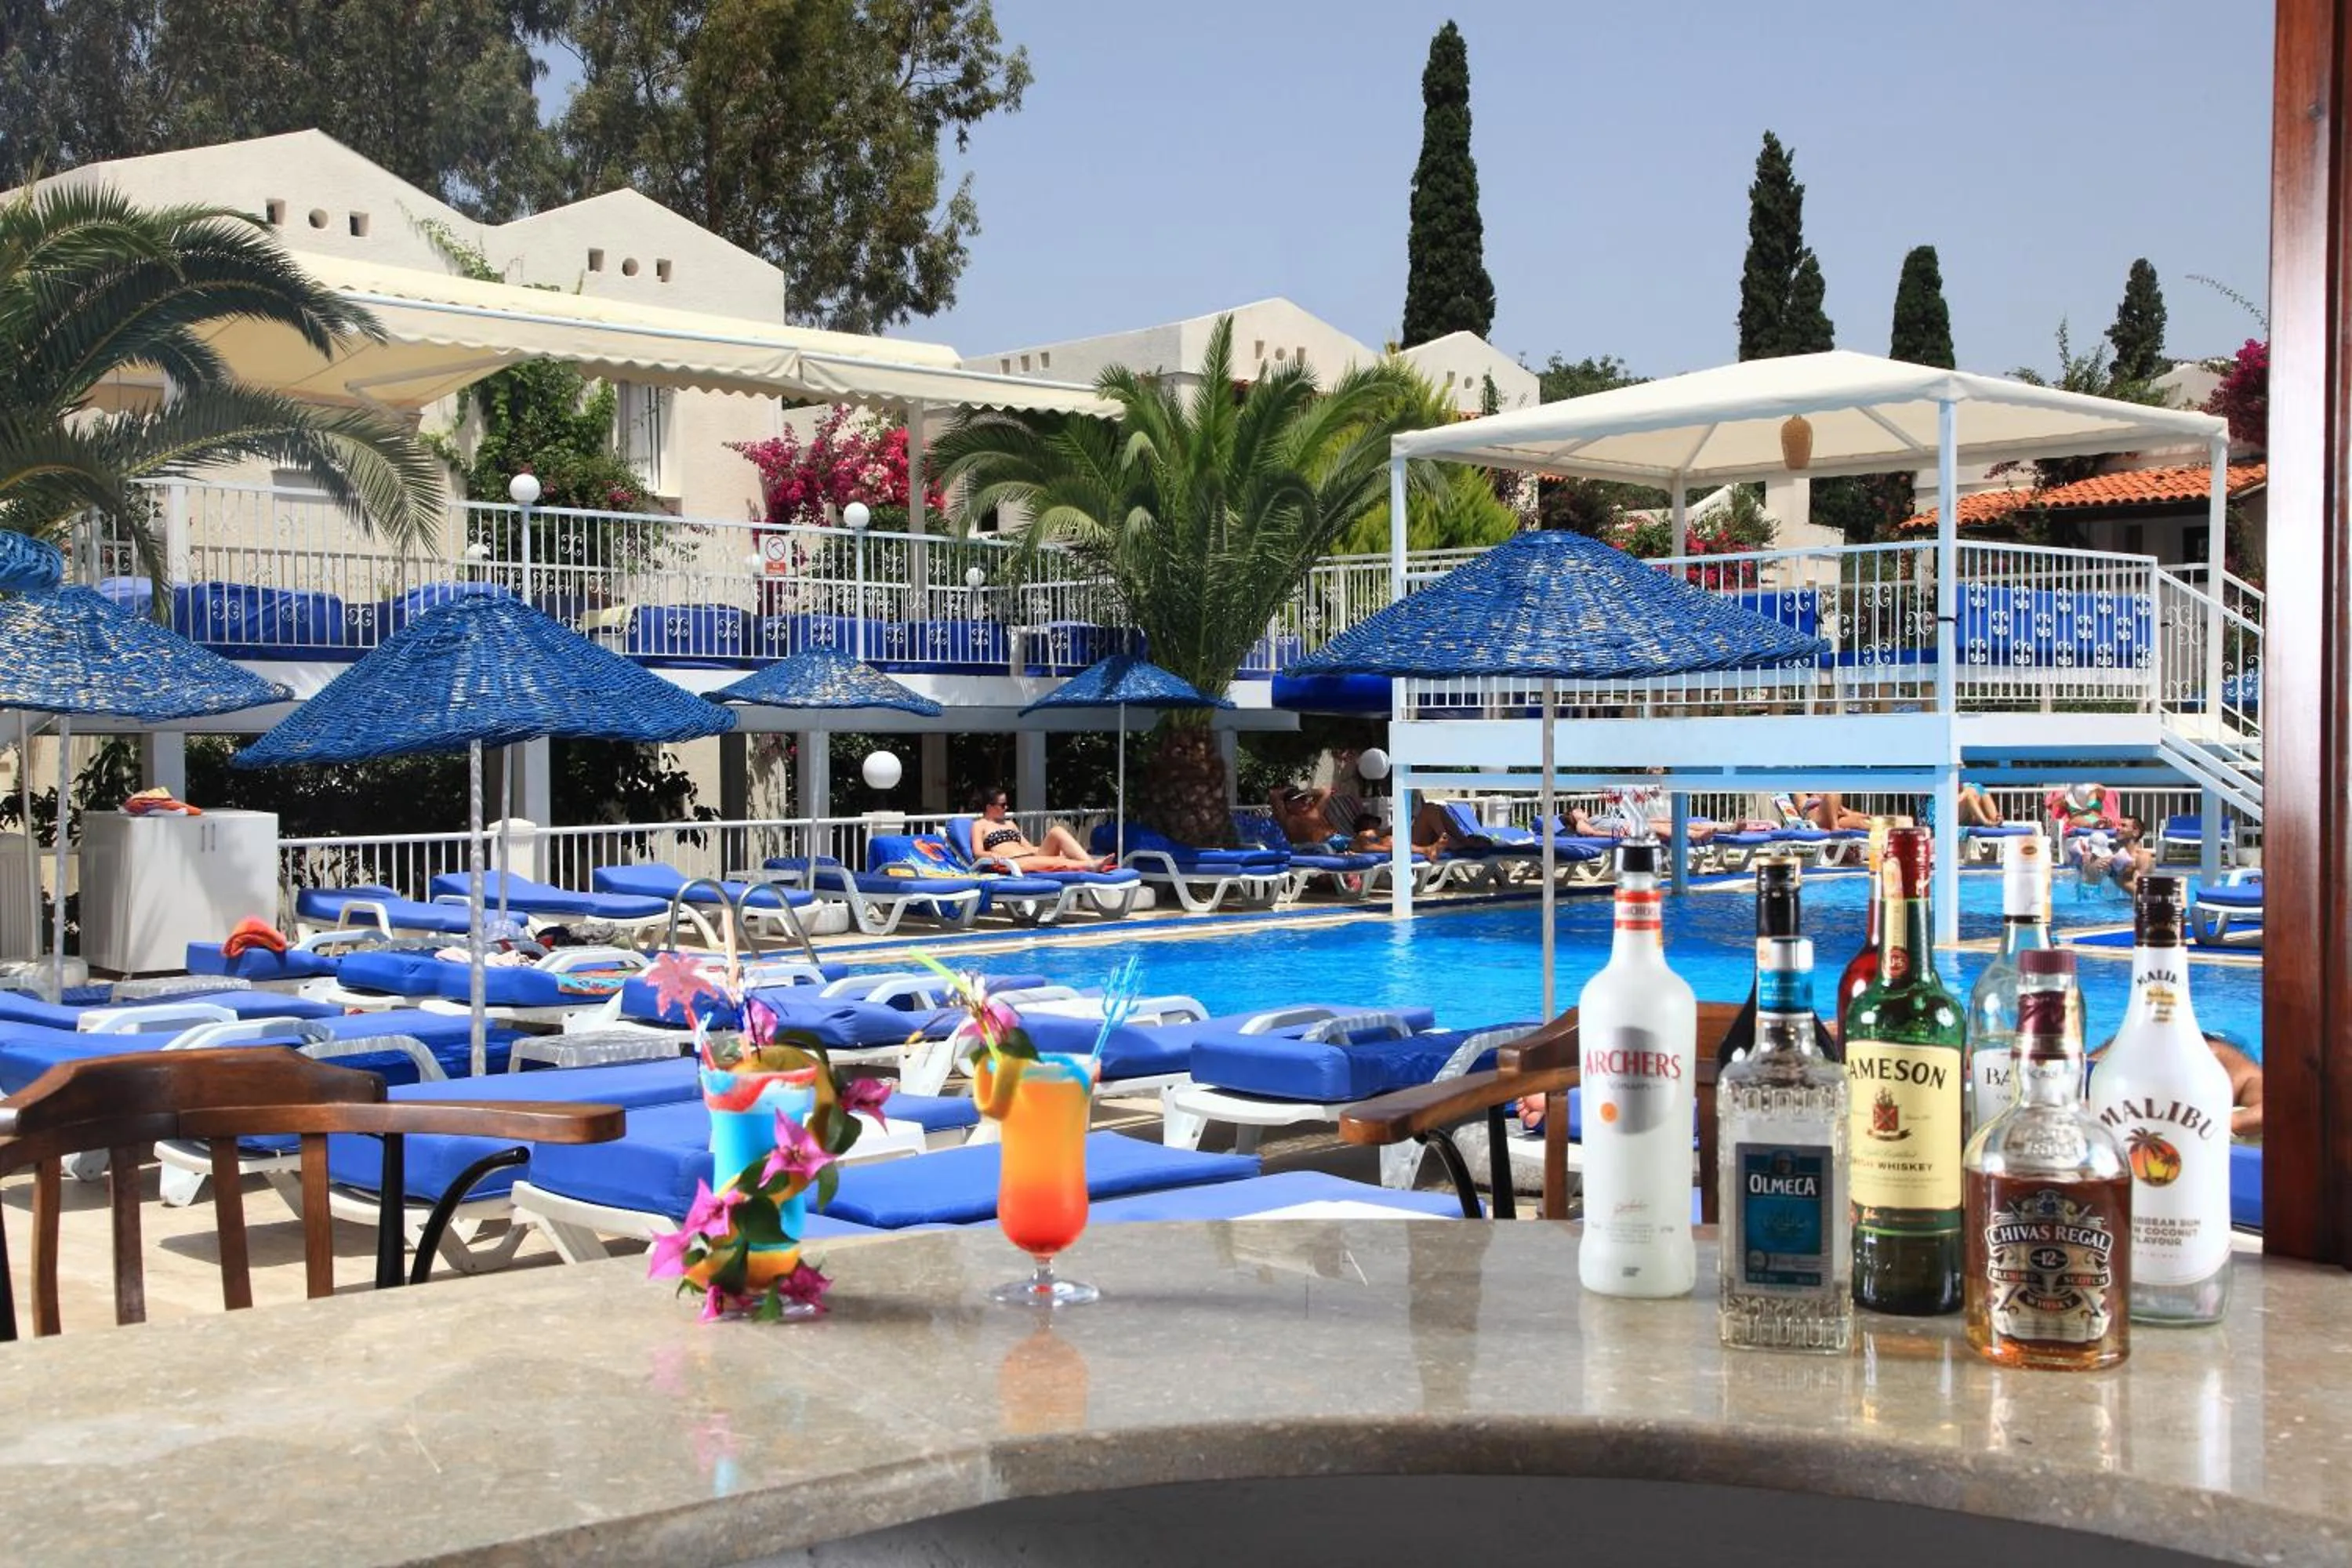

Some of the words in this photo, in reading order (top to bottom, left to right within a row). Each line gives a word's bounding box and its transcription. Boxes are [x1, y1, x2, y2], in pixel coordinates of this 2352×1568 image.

[1584, 1048, 1682, 1080] ARCHERS
[1849, 1058, 1947, 1091] AMESON
[2100, 1098, 2216, 1140] MALIBU
[1878, 1162, 1933, 1171] WHISKEY
[1749, 1174, 1817, 1196] OLMECA
[1990, 1225, 2050, 1244] CHIVAS
[2055, 1225, 2107, 1250] REGAL
[2041, 1251, 2057, 1266] 12
[2063, 1275, 2107, 1287] SCOTCH
[2026, 1295, 2074, 1309] WHISKY
